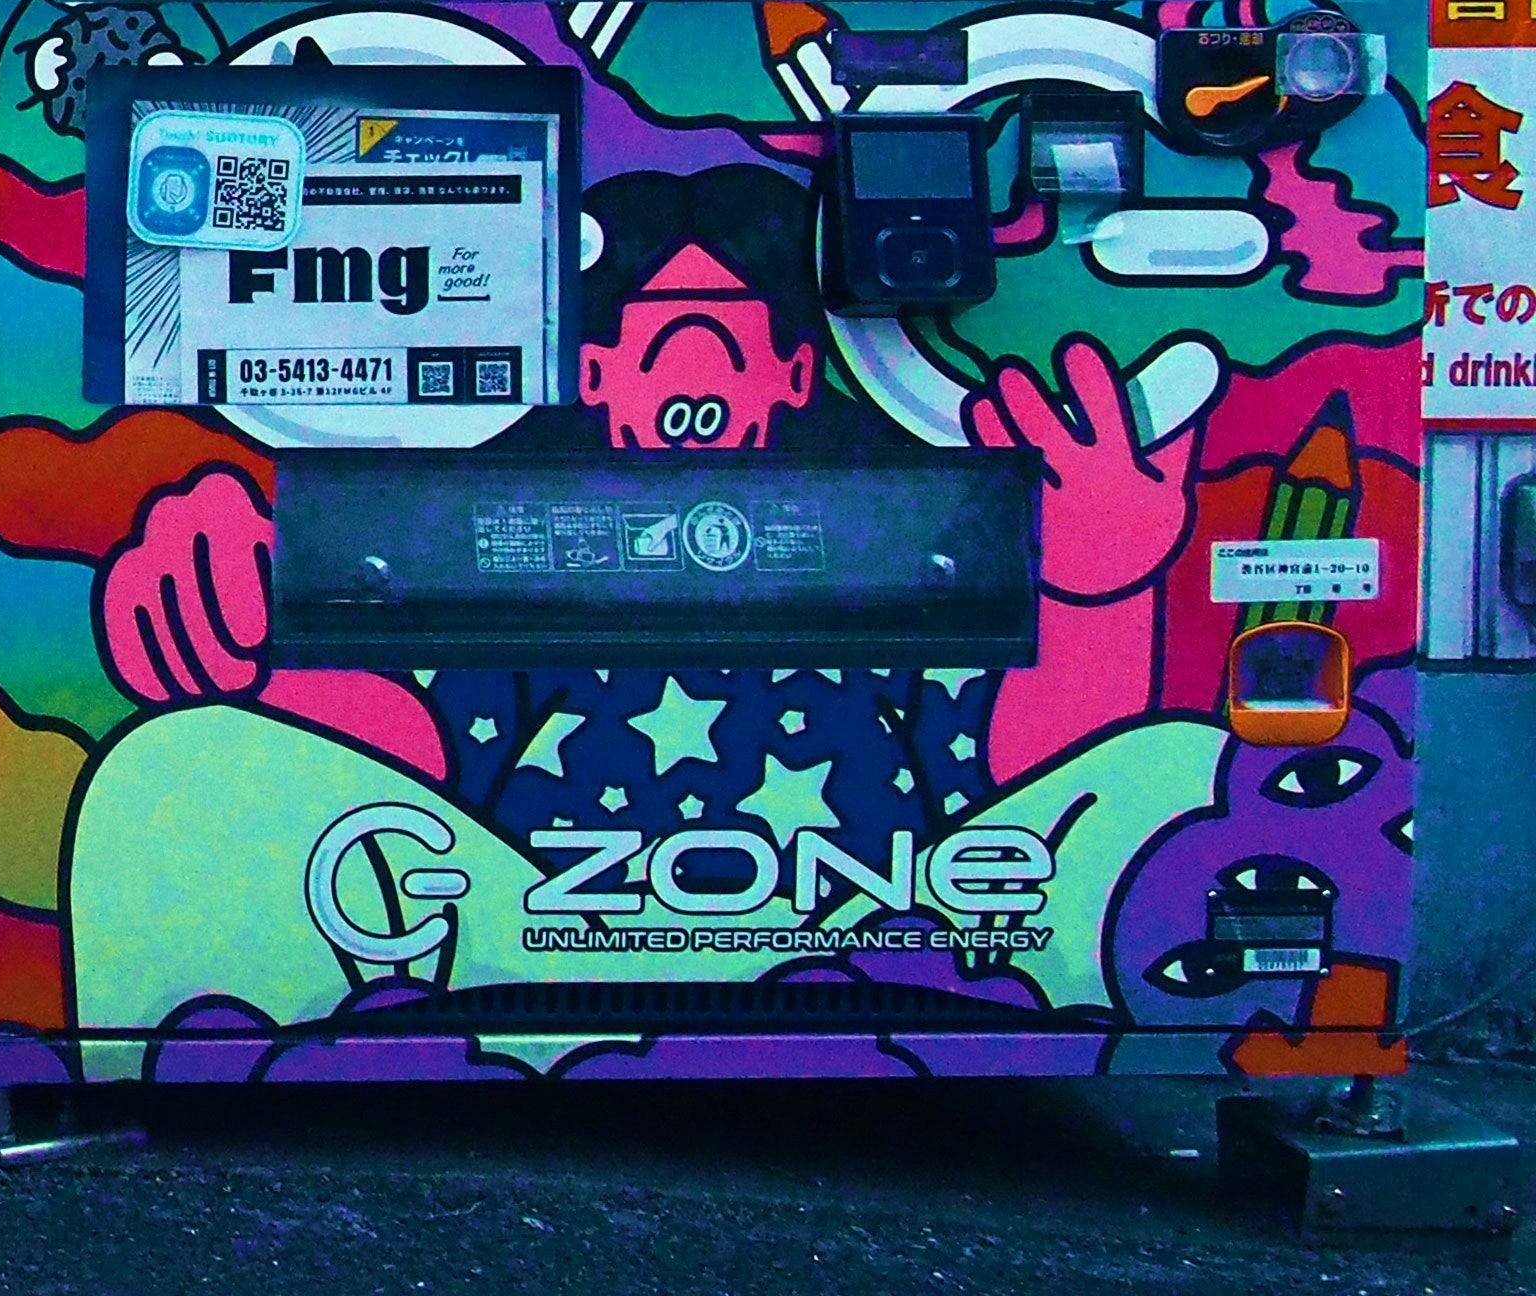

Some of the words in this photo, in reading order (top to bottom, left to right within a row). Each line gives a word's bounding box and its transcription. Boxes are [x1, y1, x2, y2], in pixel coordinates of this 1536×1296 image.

[452, 247, 481, 260] For
[439, 263, 476, 274] more
[443, 273, 491, 290] good!
[239, 357, 393, 382] 03-5413-4471
[523, 927, 690, 953] UNLIMITED
[691, 927, 928, 954] PERFORMANCE
[929, 927, 1054, 954] ENERGY
